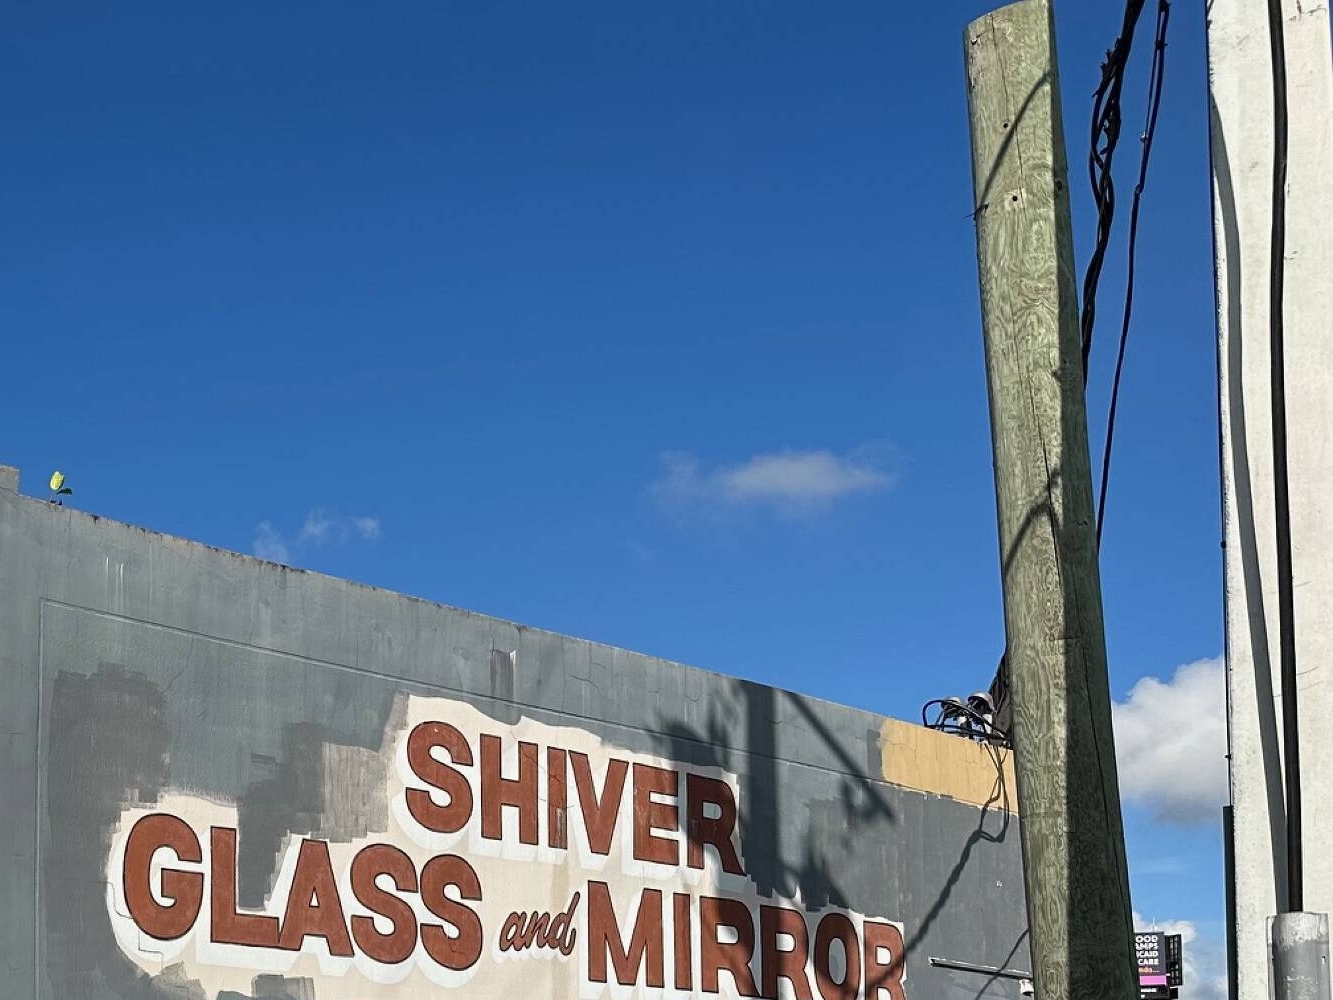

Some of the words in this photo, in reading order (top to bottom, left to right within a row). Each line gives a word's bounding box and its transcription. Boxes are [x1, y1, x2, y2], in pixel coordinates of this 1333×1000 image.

[405, 720, 745, 875] SHIVER
[122, 813, 484, 971] GLASS
[498, 891, 581, 957] and
